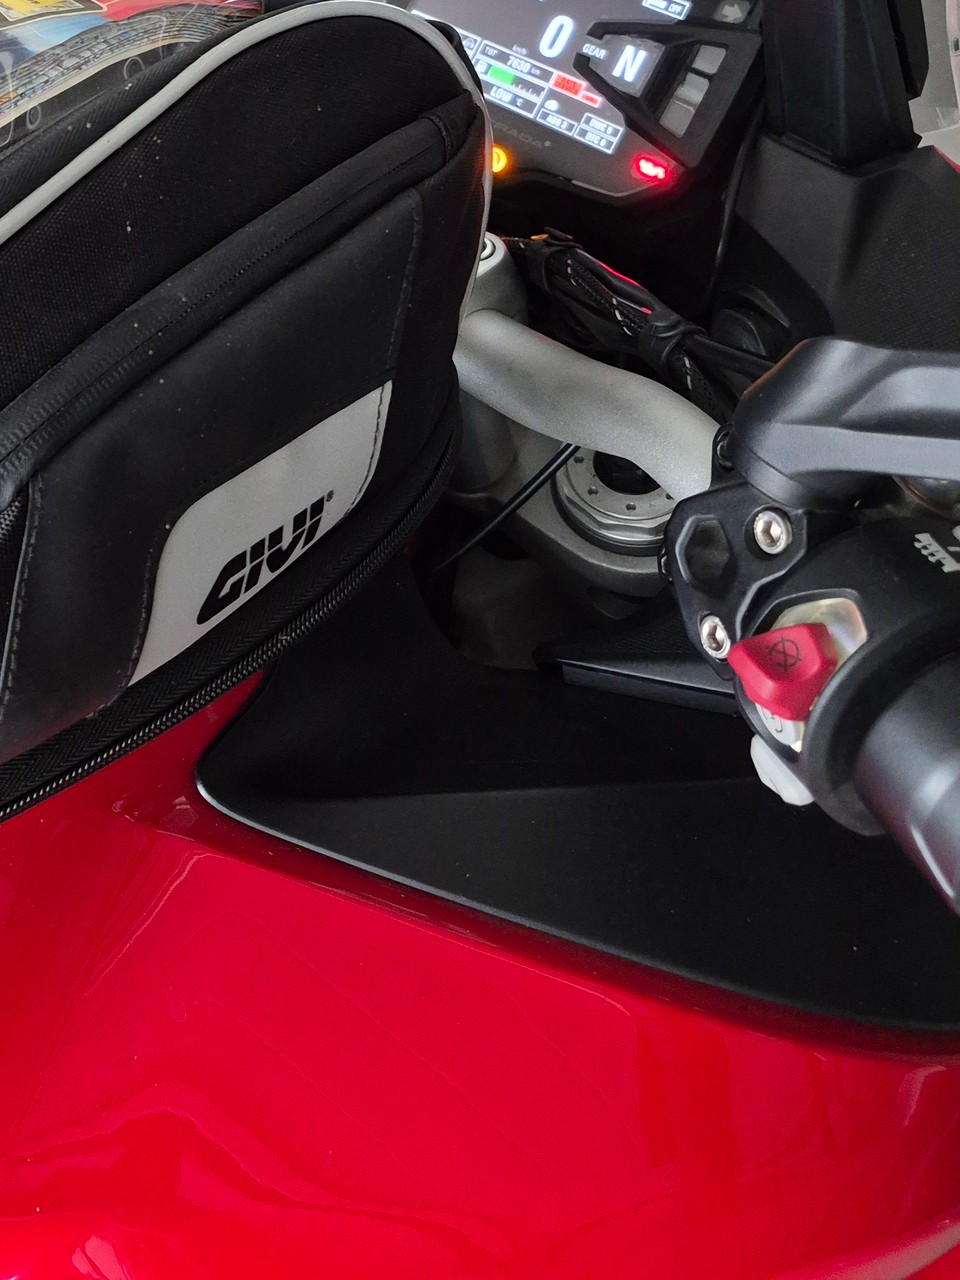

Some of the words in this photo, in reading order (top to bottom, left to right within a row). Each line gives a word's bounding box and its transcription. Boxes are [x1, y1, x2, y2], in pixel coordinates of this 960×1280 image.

[538, 15, 574, 59] 0
[483, 47, 499, 56] TOT
[506, 56, 531, 74] 7630
[582, 43, 608, 60] GEAR
[612, 45, 647, 83] N
[490, 86, 512, 103] LOW
